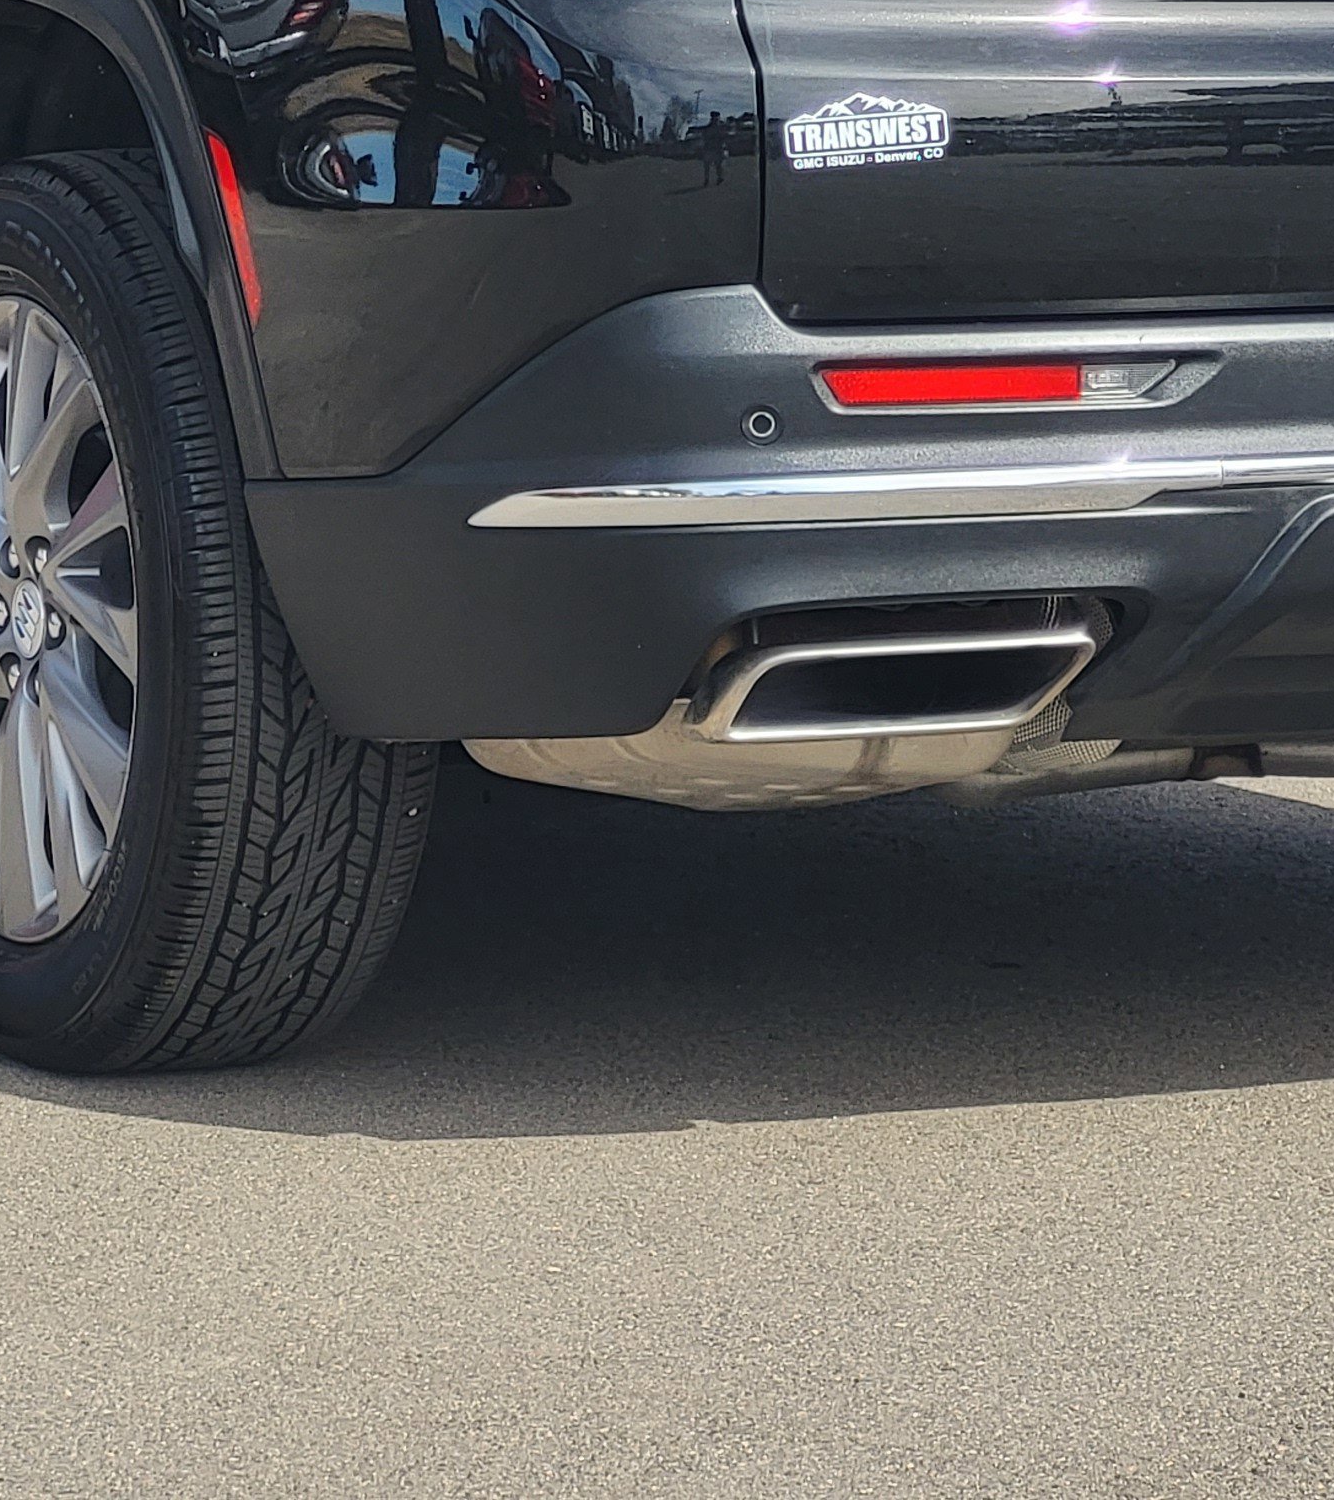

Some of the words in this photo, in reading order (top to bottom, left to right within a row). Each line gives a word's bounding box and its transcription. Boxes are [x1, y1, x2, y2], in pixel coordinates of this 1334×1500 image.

[789, 113, 943, 153] TRANSWEST
[793, 157, 824, 170] GMC
[826, 153, 866, 168] ISUZU
[923, 147, 944, 160] CO
